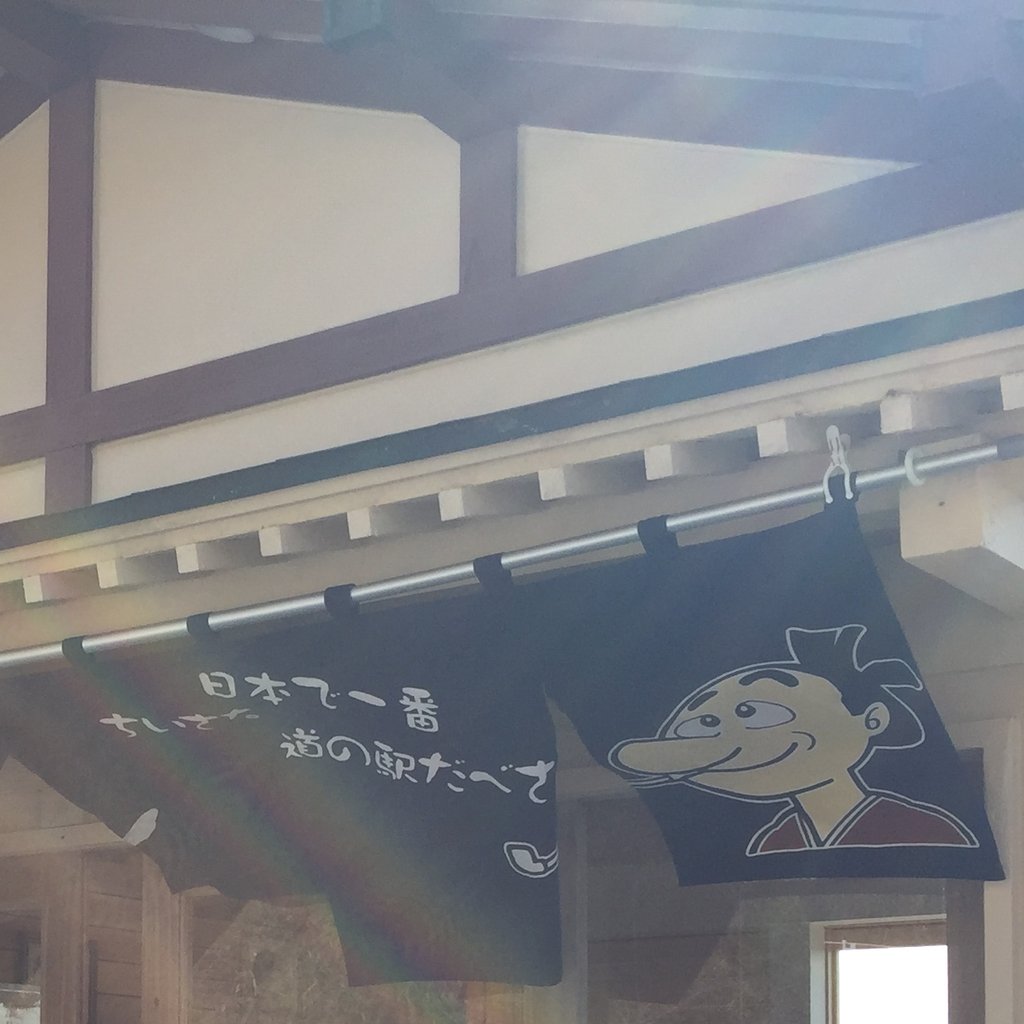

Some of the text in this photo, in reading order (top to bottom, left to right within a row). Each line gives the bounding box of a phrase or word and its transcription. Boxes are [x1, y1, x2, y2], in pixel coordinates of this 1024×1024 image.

[198, 671, 439, 732] 日本で一番
[279, 728, 556, 804] 道の駅だべさ
